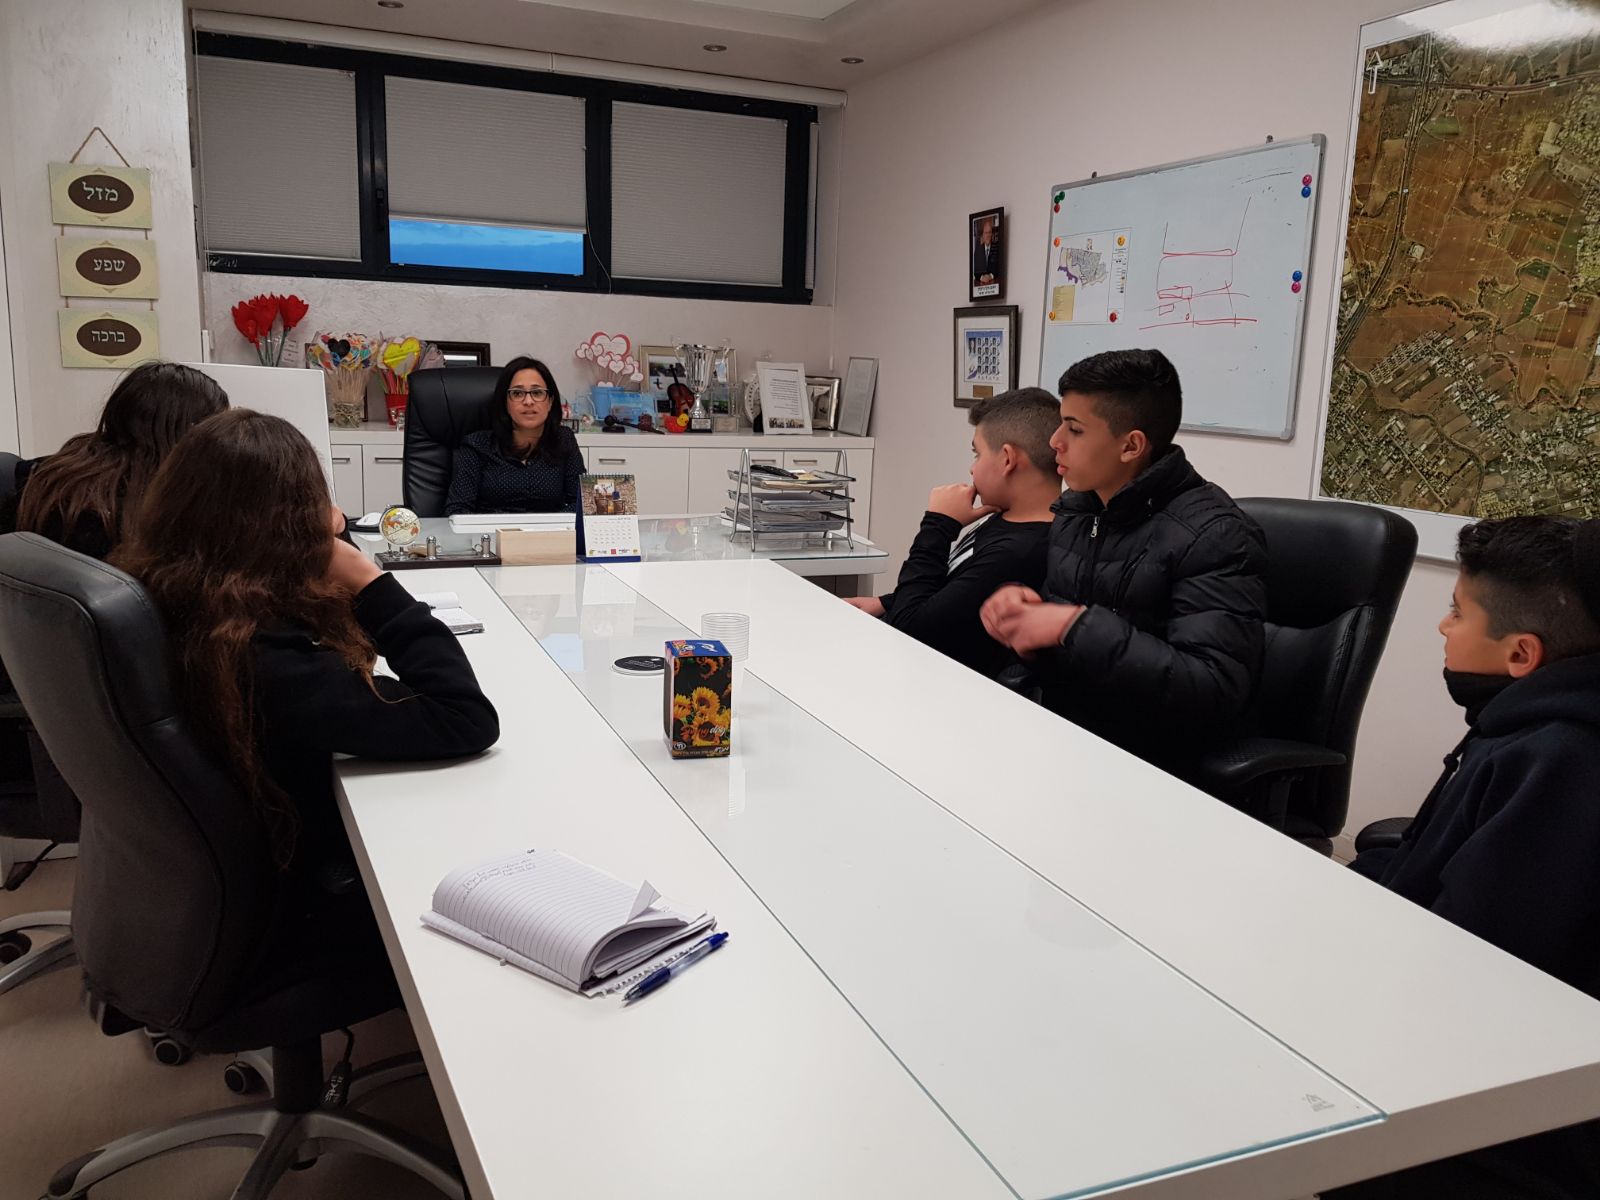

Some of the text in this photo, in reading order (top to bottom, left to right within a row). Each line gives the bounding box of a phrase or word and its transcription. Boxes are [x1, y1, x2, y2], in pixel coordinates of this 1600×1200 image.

[82, 181, 119, 202] מזל
[93, 258, 125, 272] שפע
[91, 330, 126, 343] ברכה
